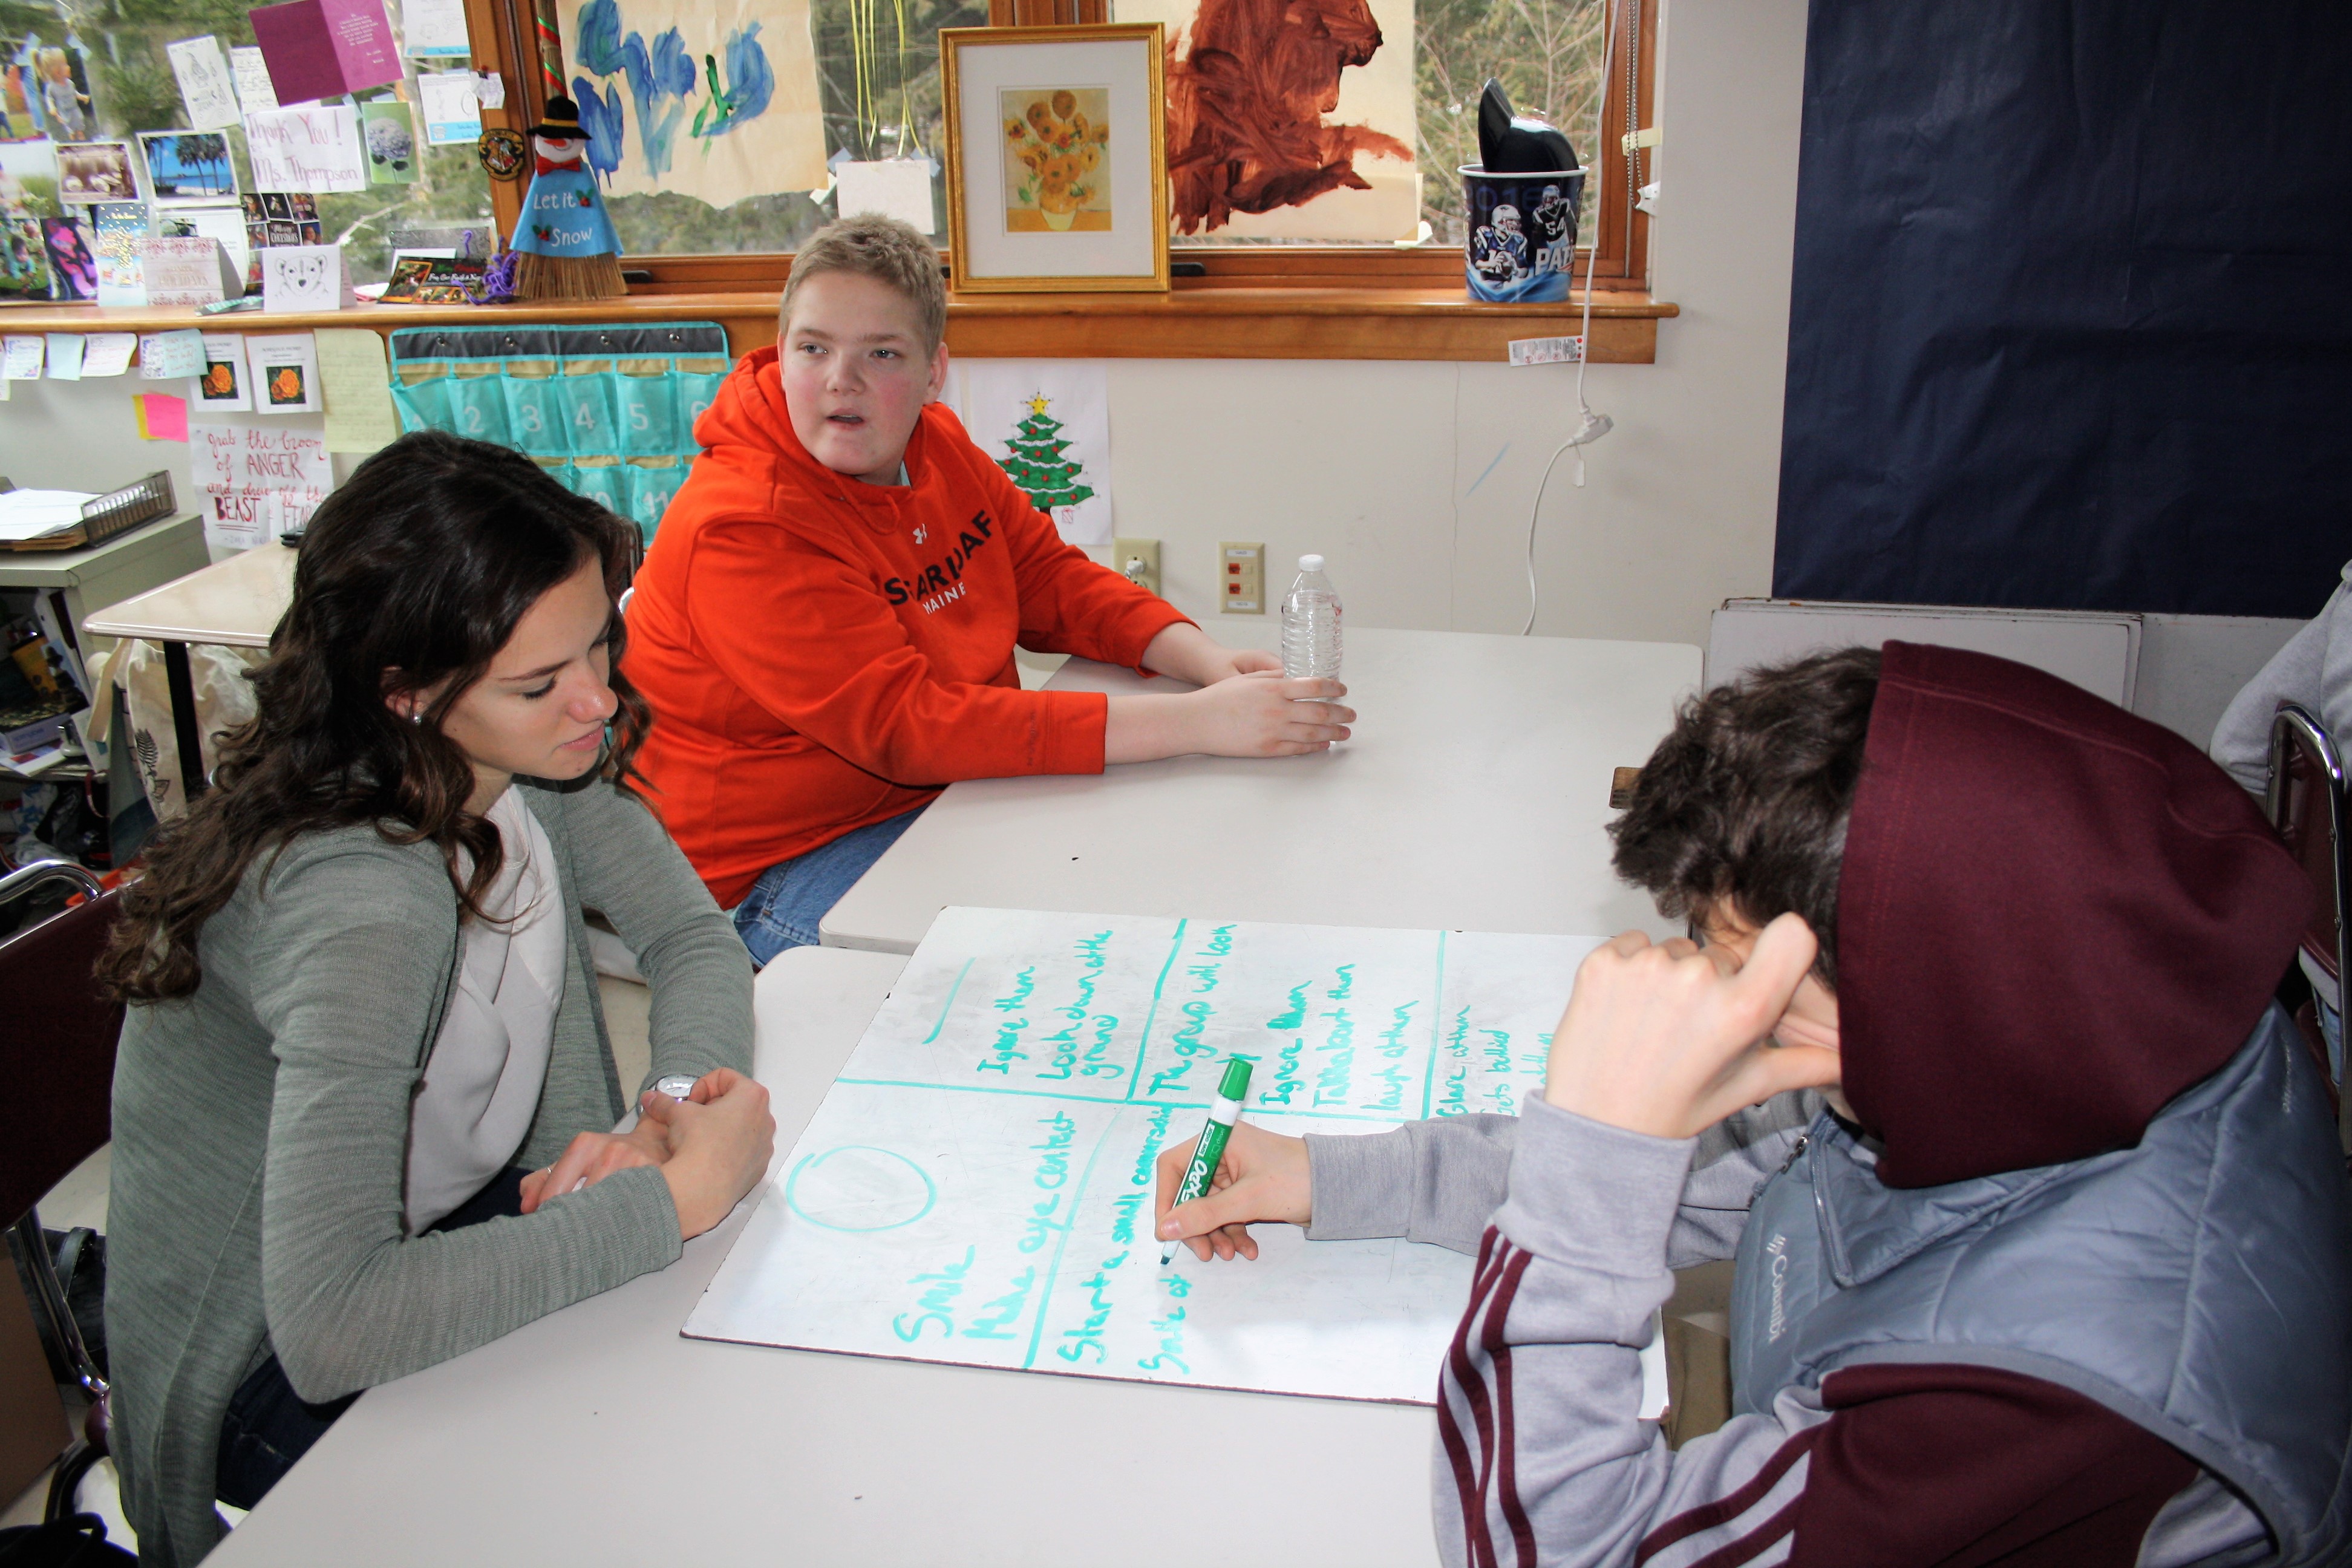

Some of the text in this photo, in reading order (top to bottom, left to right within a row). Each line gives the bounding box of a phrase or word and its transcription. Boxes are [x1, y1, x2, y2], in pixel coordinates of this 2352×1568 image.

[245, 113, 293, 148] Thank
[253, 155, 359, 191] Ms. Thompson
[533, 192, 577, 210] Let it
[551, 227, 593, 247] Snow
[1545, 219, 1565, 235] 54
[464, 405, 484, 433] 2
[521, 405, 541, 432] 3
[575, 403, 595, 430] 4
[629, 403, 650, 430] 5
[207, 429, 326, 461] grab the broom
[217, 452, 306, 482] of ANGER
[207, 483, 232, 495] and
[242, 483, 271, 497] drive
[214, 495, 261, 524] BEAST
[922, 581, 967, 615] MAINE
[1185, 962, 1223, 993] will
[1326, 963, 1356, 1001] them
[1171, 1001, 1219, 1059] group
[1146, 1059, 1194, 1096] The
[1258, 1037, 1307, 1106] Ignore
[1199, 1126, 1214, 1156] low odor
[1017, 1193, 1074, 1254] eye
[1111, 1191, 1150, 1246] small
[1101, 1249, 1130, 1270] a
[893, 1244, 976, 1344] Smile
[1056, 1271, 1114, 1365] Start
[1137, 1273, 1192, 1375] Smile at
